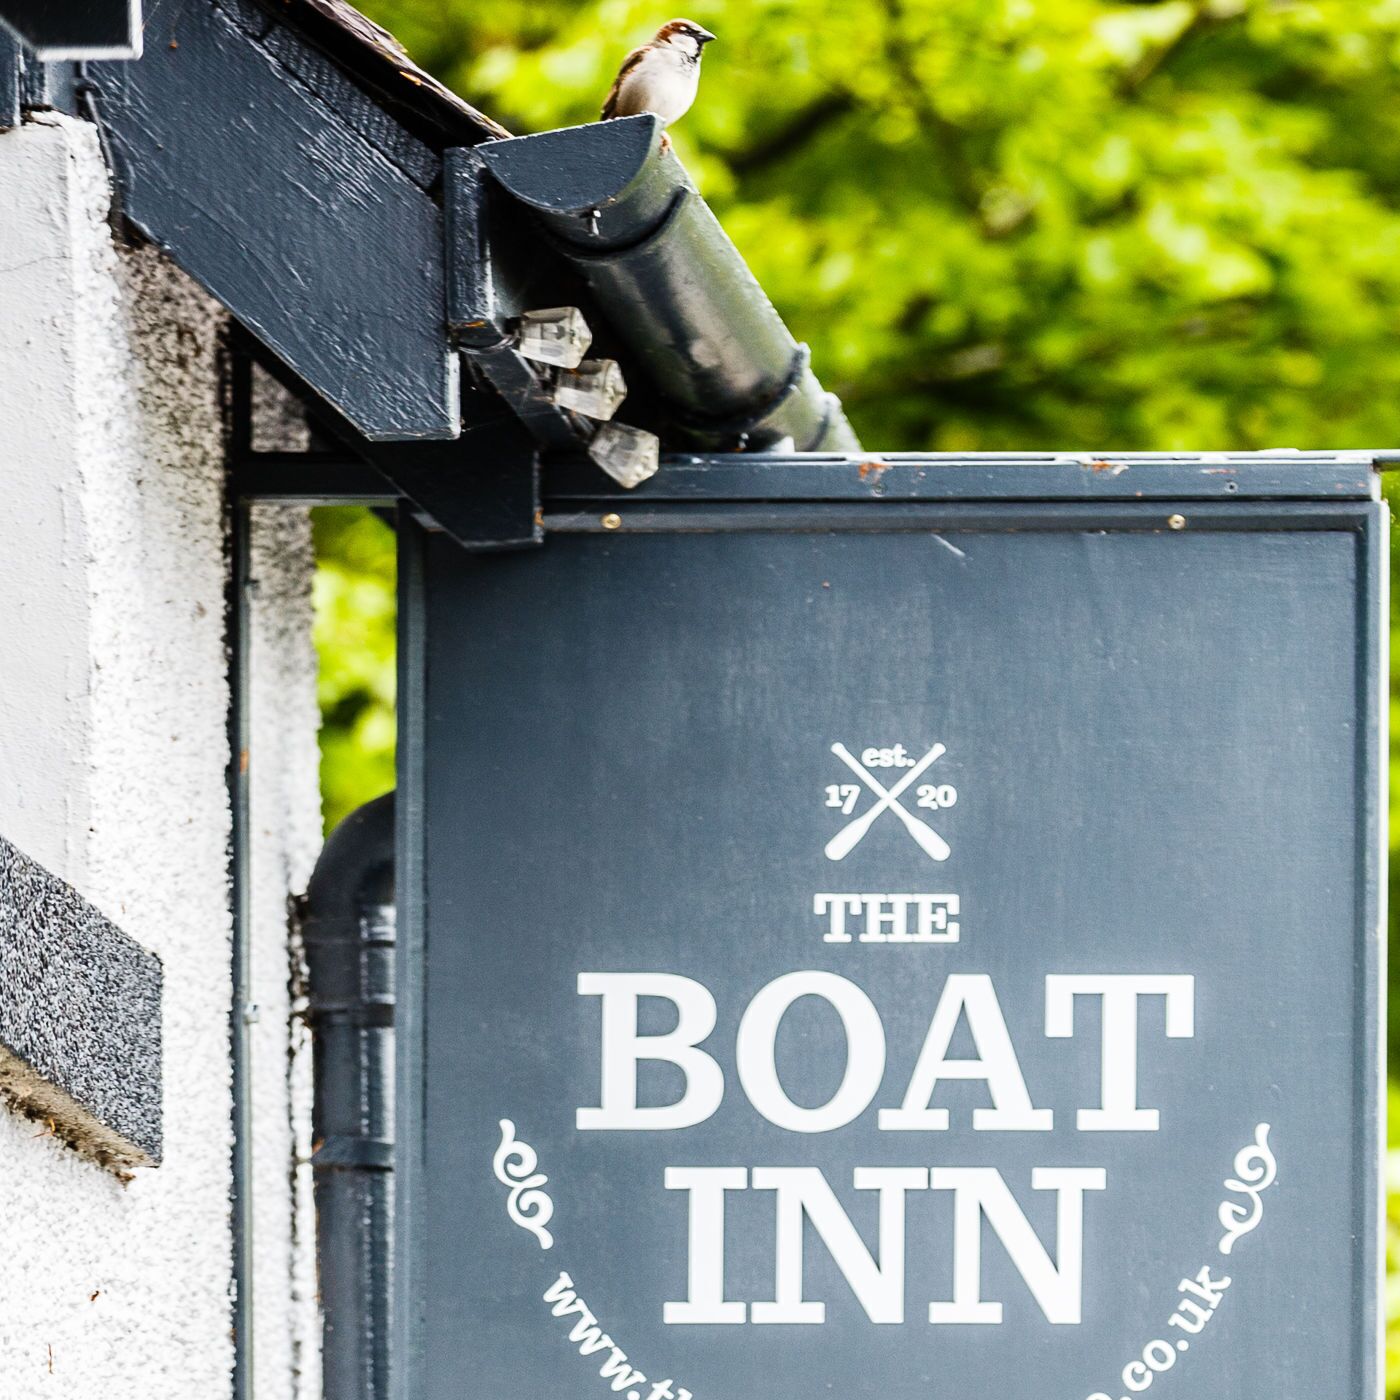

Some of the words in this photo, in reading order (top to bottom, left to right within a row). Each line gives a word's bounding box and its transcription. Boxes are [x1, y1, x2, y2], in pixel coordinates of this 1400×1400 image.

[861, 743, 917, 768] est.
[825, 784, 861, 815] 17
[916, 784, 958, 810] 20
[813, 893, 960, 943] THE
[576, 970, 1195, 1133] BOAT
[663, 1166, 1107, 1325] INN
